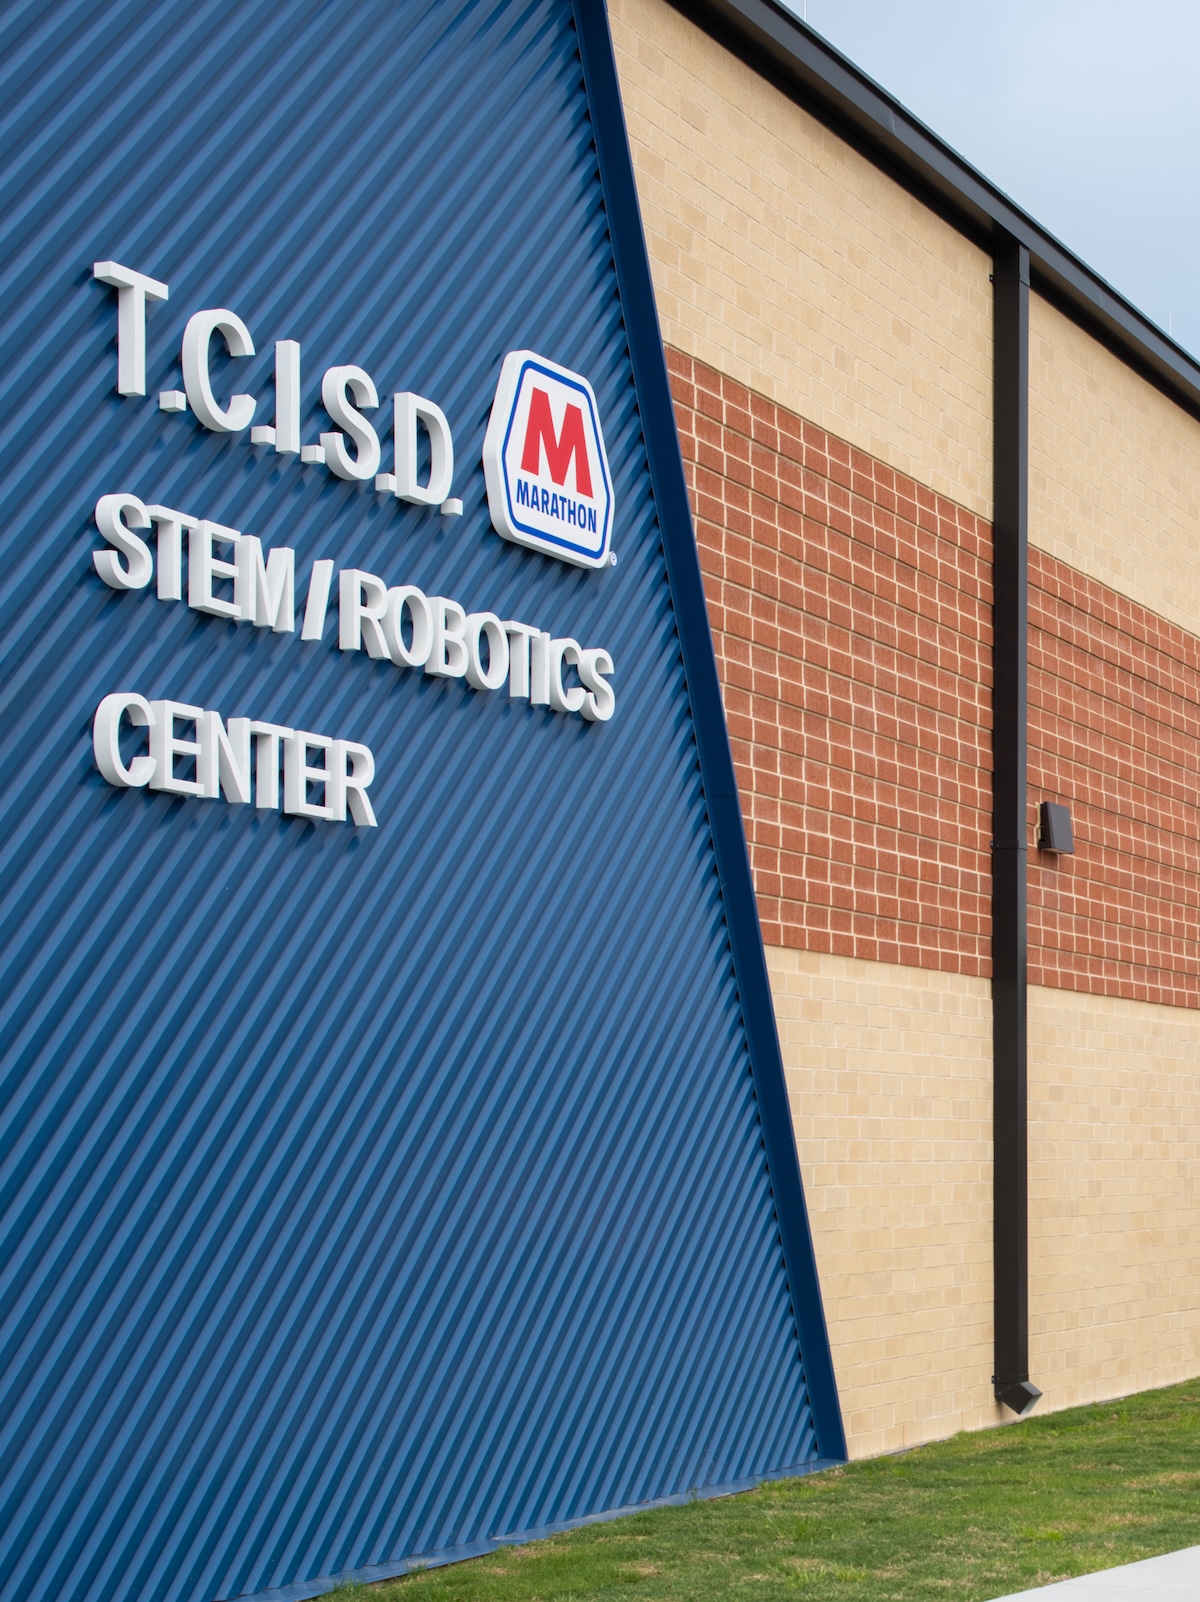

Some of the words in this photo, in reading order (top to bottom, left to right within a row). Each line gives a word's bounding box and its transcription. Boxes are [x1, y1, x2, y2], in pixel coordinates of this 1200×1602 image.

[94, 261, 463, 515] T.C.I.S.D.
[520, 386, 594, 499] M
[516, 478, 597, 534] MARATHON
[93, 692, 378, 827] CENTER
